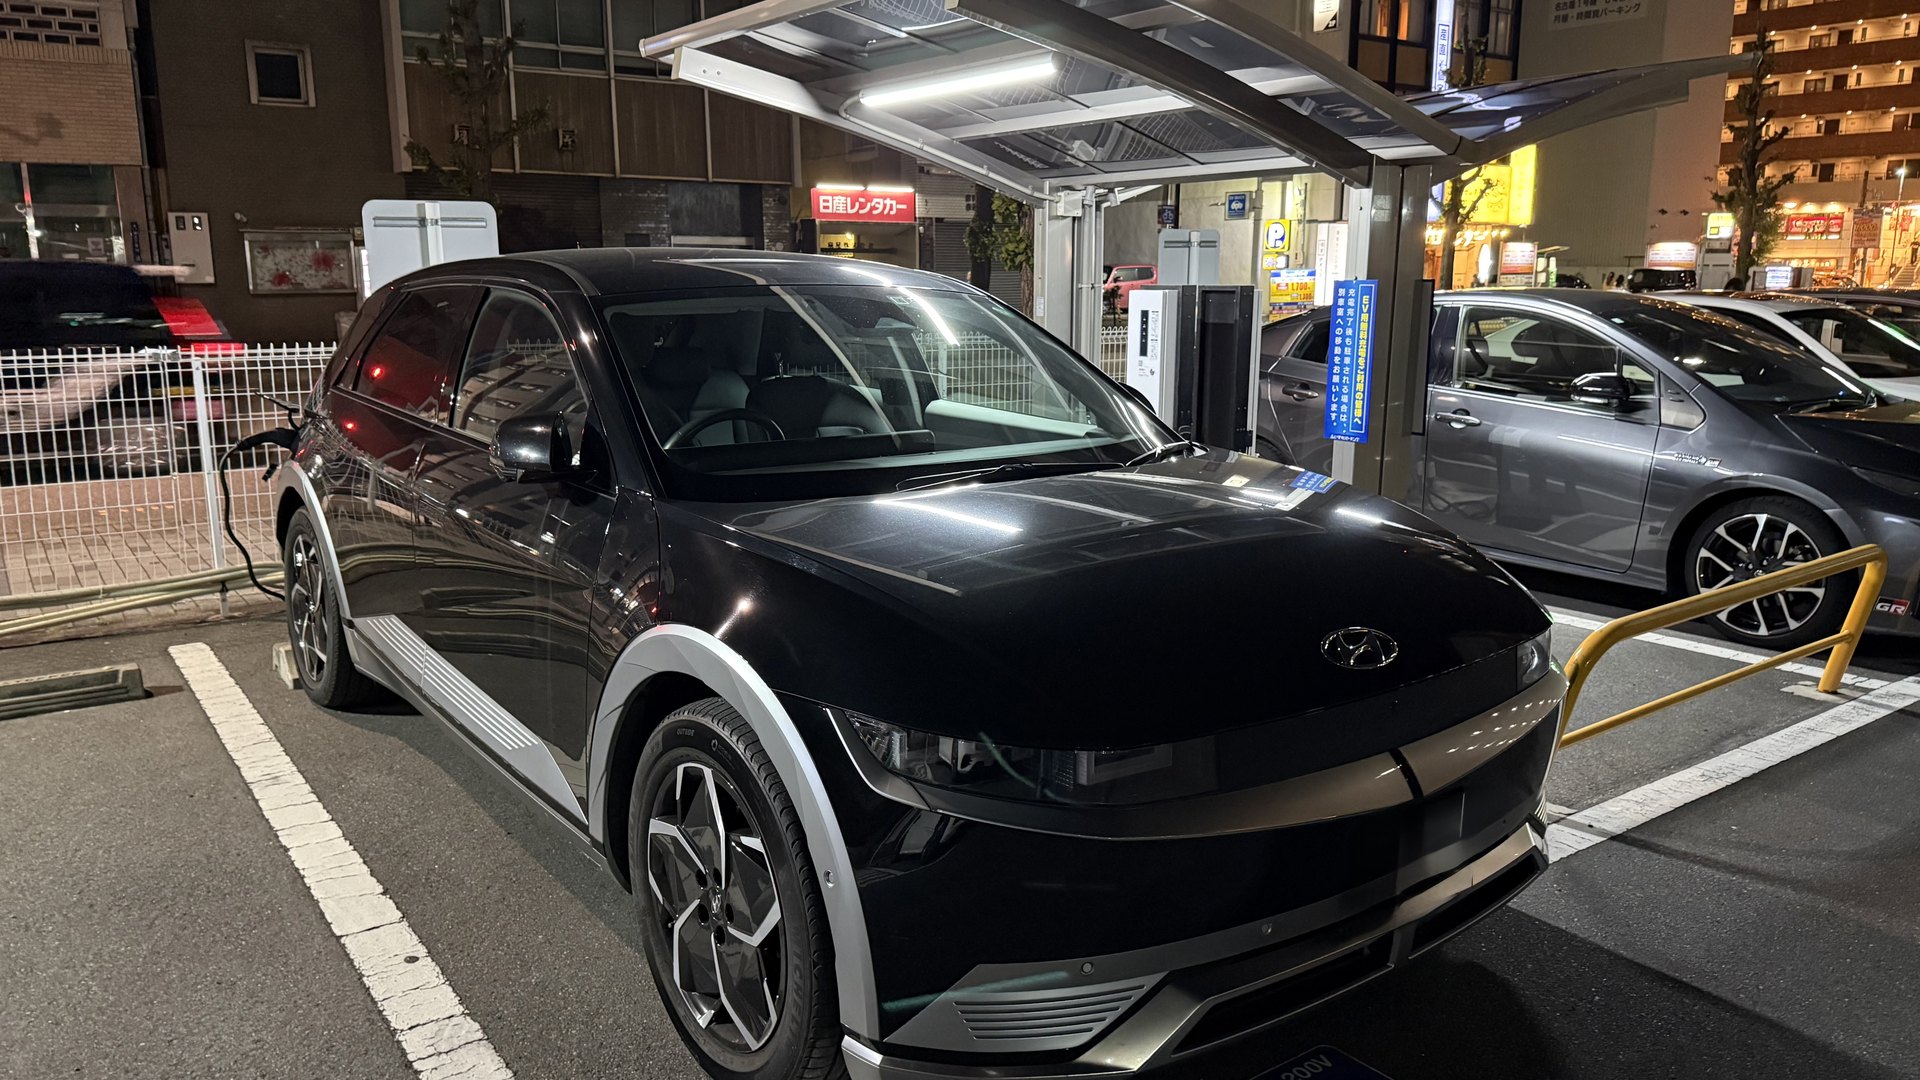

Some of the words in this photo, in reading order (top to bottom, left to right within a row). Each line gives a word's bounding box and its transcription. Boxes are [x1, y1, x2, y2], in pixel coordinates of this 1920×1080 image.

[819, 195, 908, 215] 日産レンタカー
[1876, 602, 1906, 615] GR
